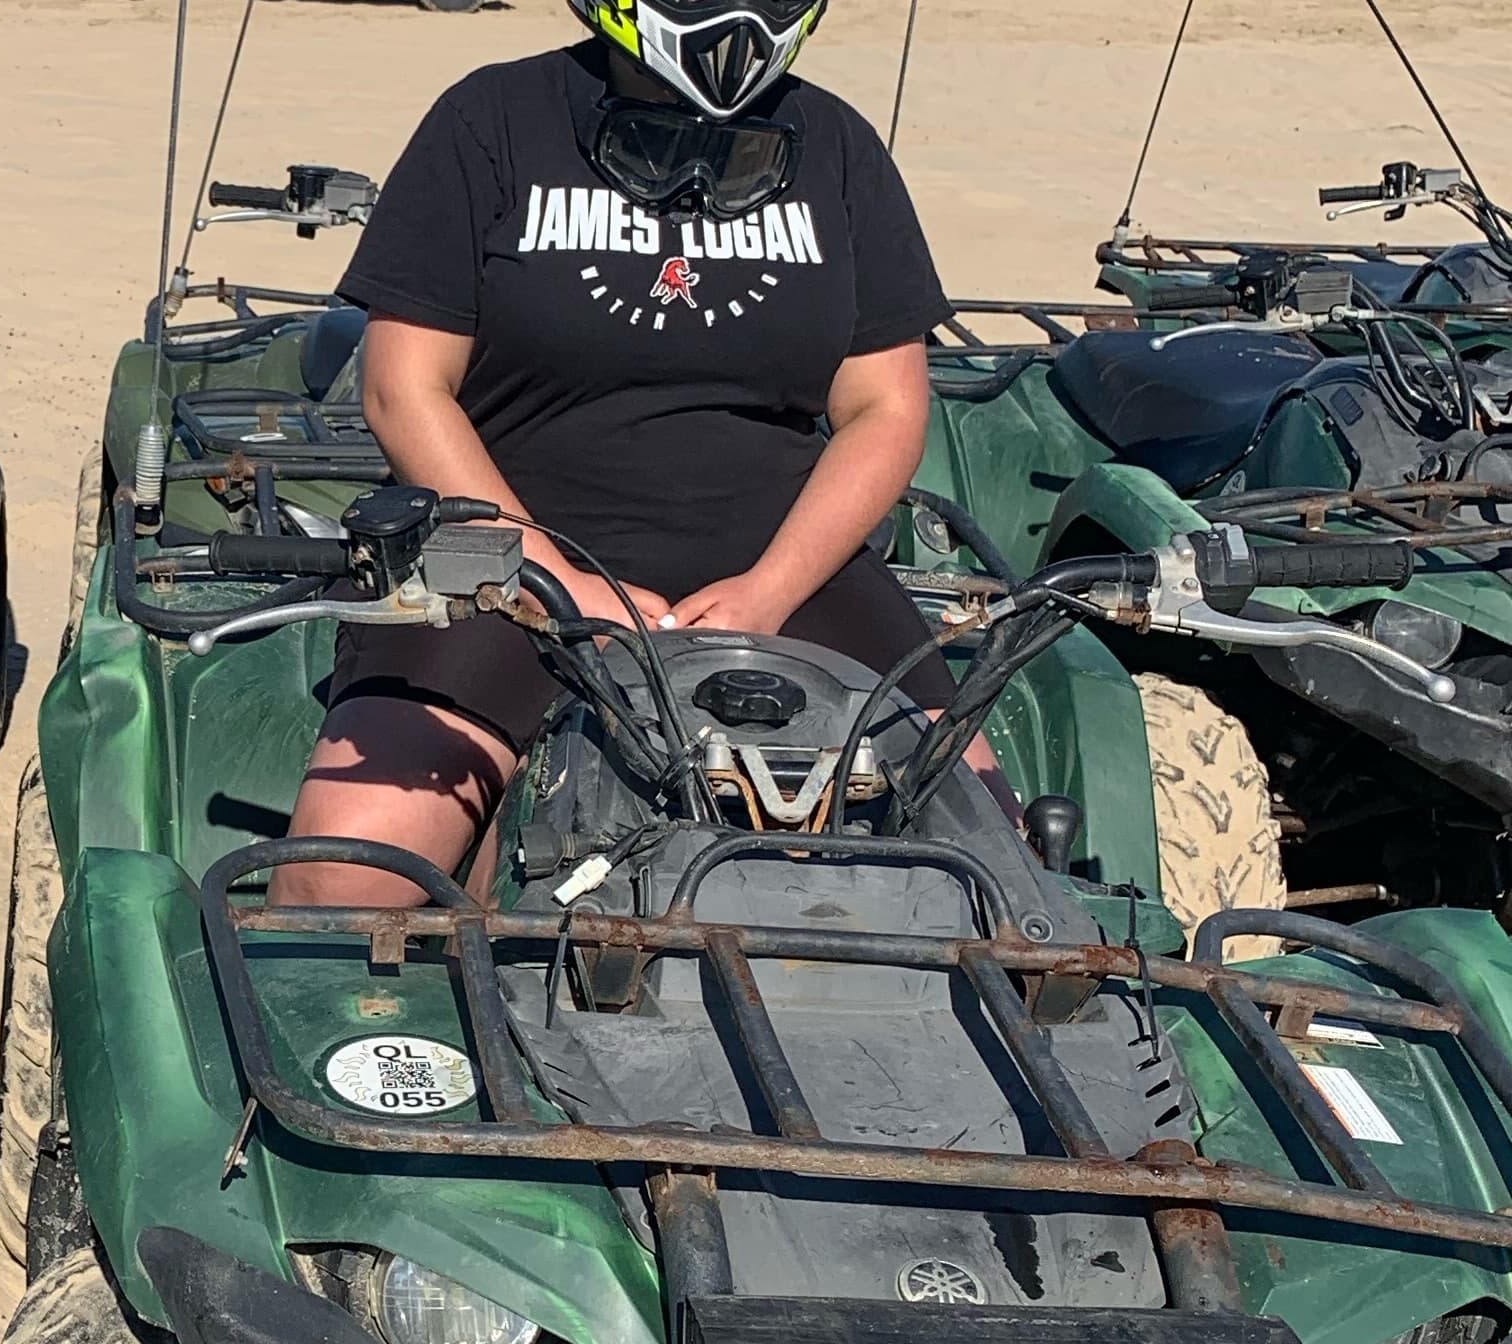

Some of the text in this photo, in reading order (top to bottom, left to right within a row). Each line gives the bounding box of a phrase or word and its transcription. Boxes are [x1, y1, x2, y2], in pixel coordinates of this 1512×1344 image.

[517, 184, 660, 255] JAMES
[580, 265, 778, 330] WATER POLO
[373, 1044, 427, 1063] QL
[379, 1091, 446, 1107] 055
